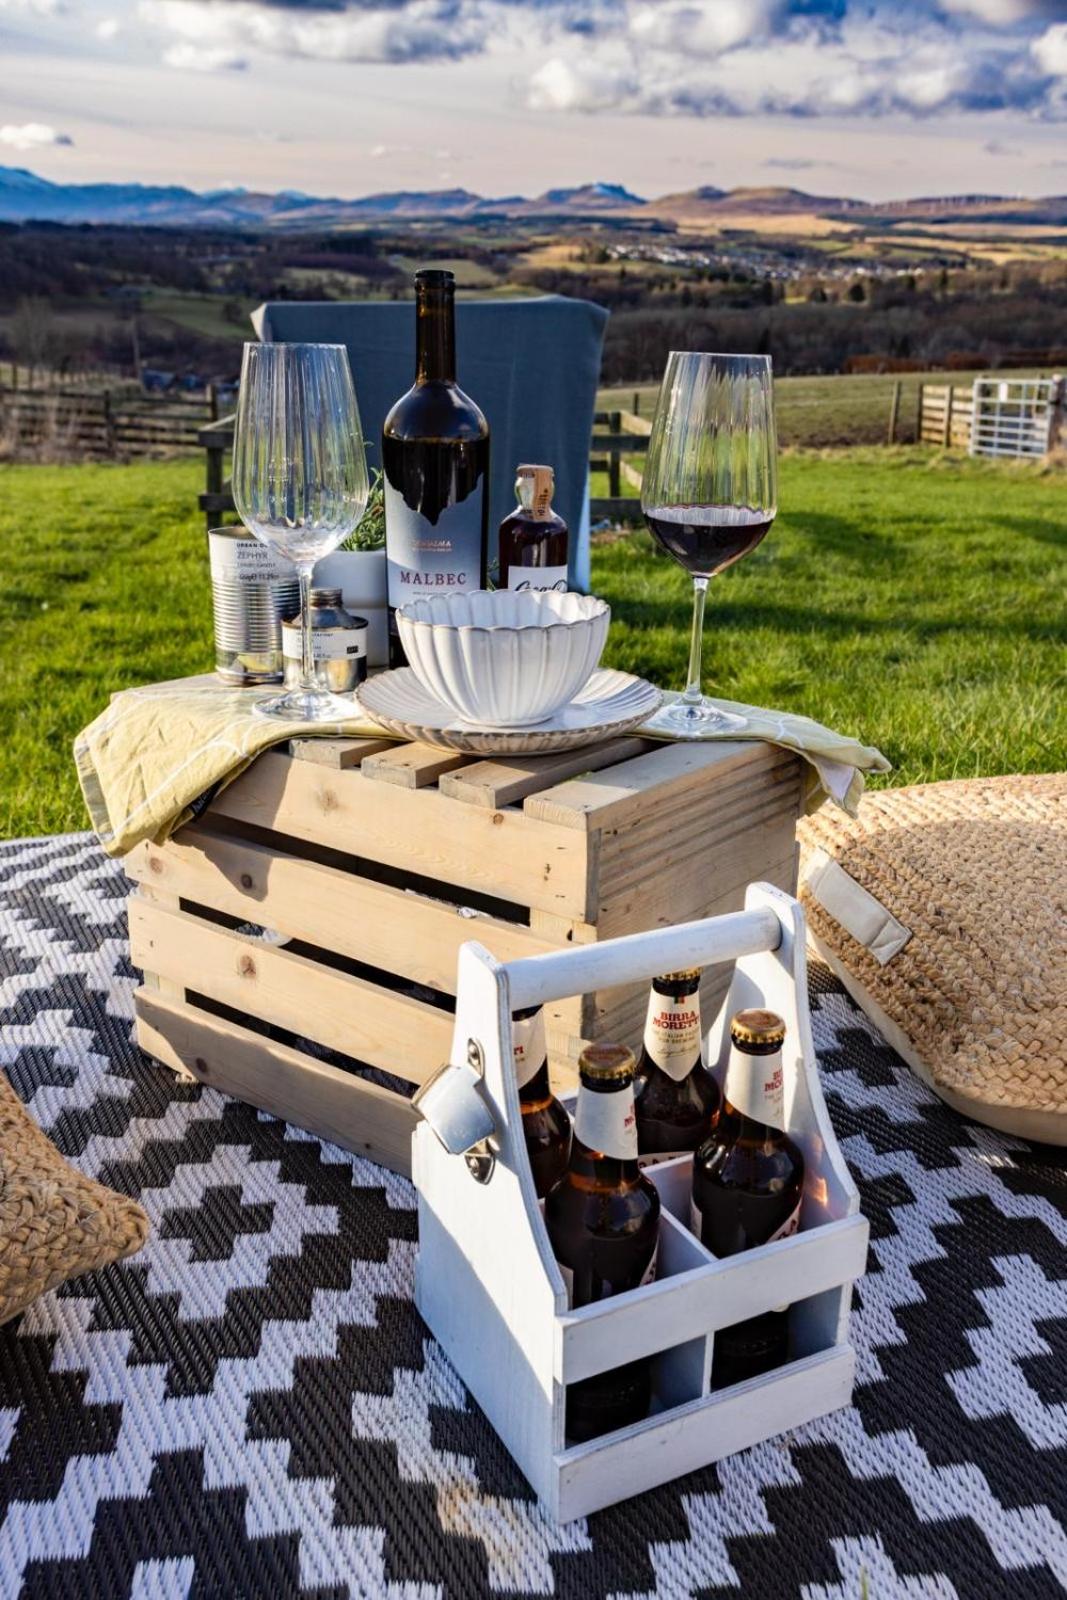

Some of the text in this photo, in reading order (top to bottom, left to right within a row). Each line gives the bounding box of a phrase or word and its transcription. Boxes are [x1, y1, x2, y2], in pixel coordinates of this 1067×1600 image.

[237, 551, 268, 560] ZEPHYR
[400, 570, 467, 586] MALBEC
[660, 1010, 696, 1022] BIRRA
